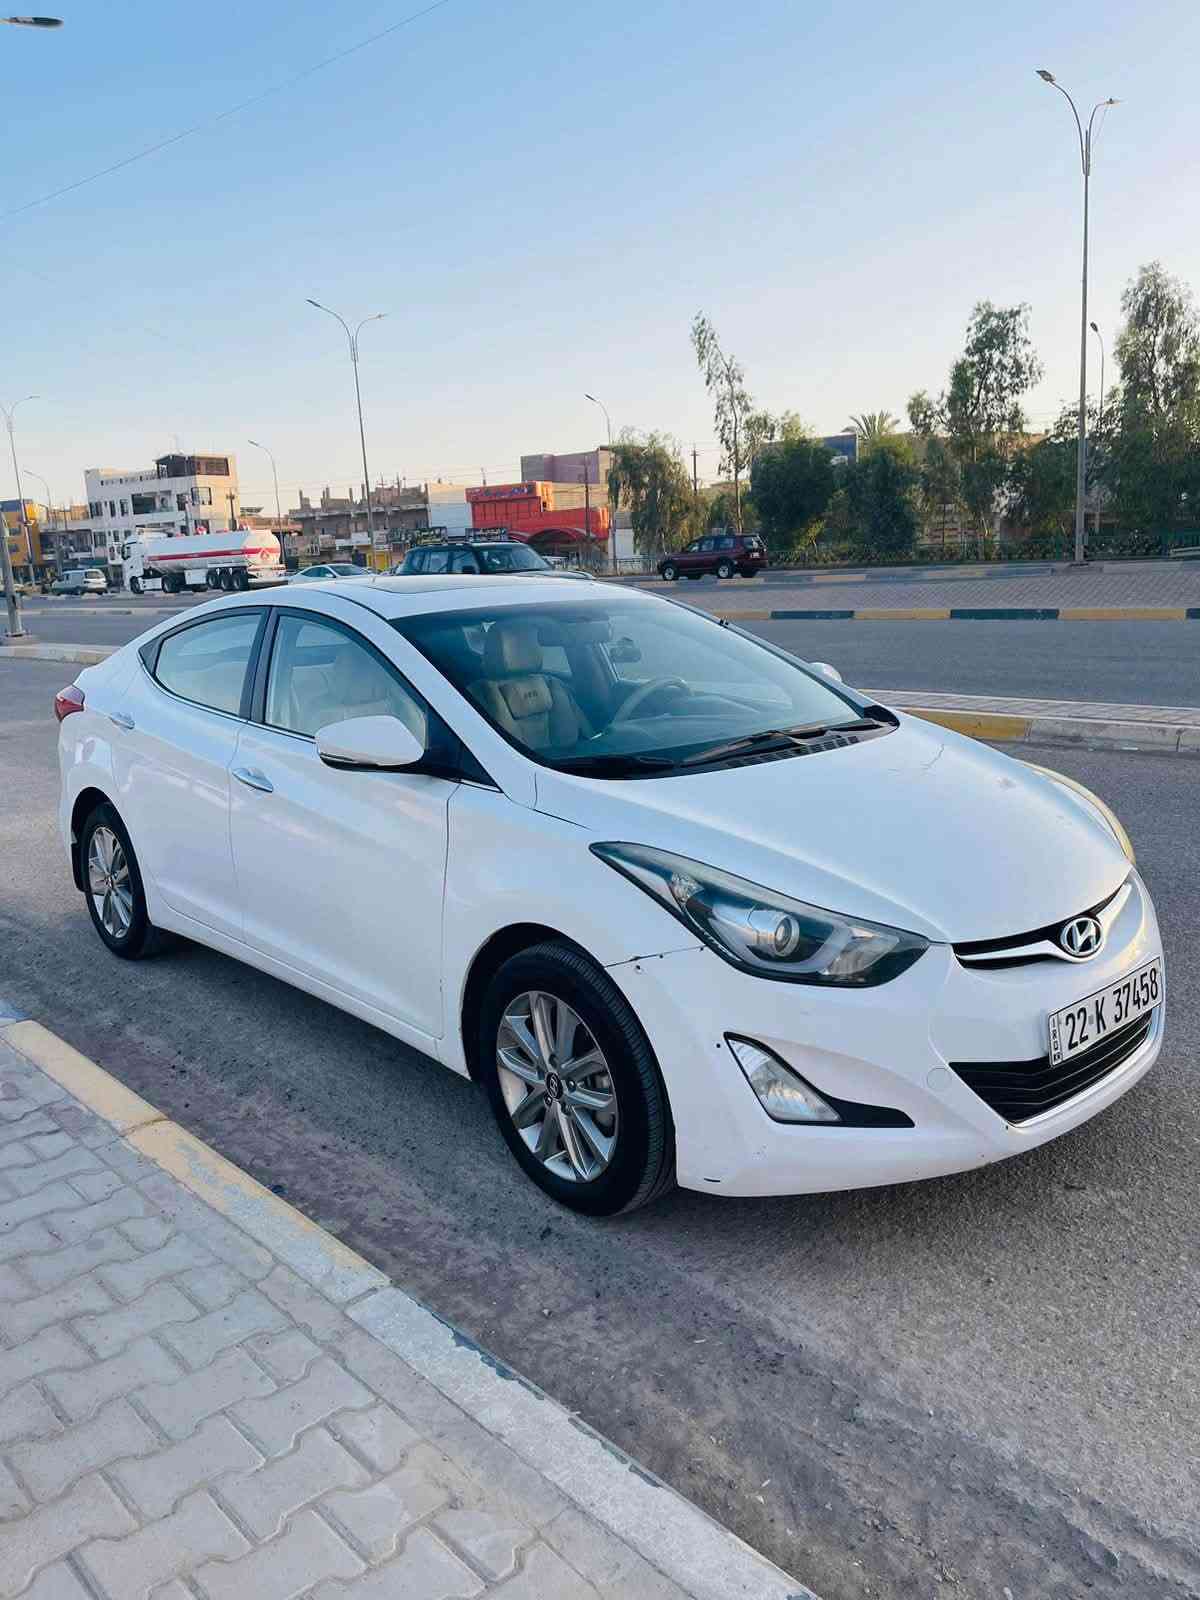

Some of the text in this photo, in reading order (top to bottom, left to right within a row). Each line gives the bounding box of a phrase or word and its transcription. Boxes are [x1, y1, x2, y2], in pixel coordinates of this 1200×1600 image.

[1065, 968, 1158, 1050] 22 K 37458
